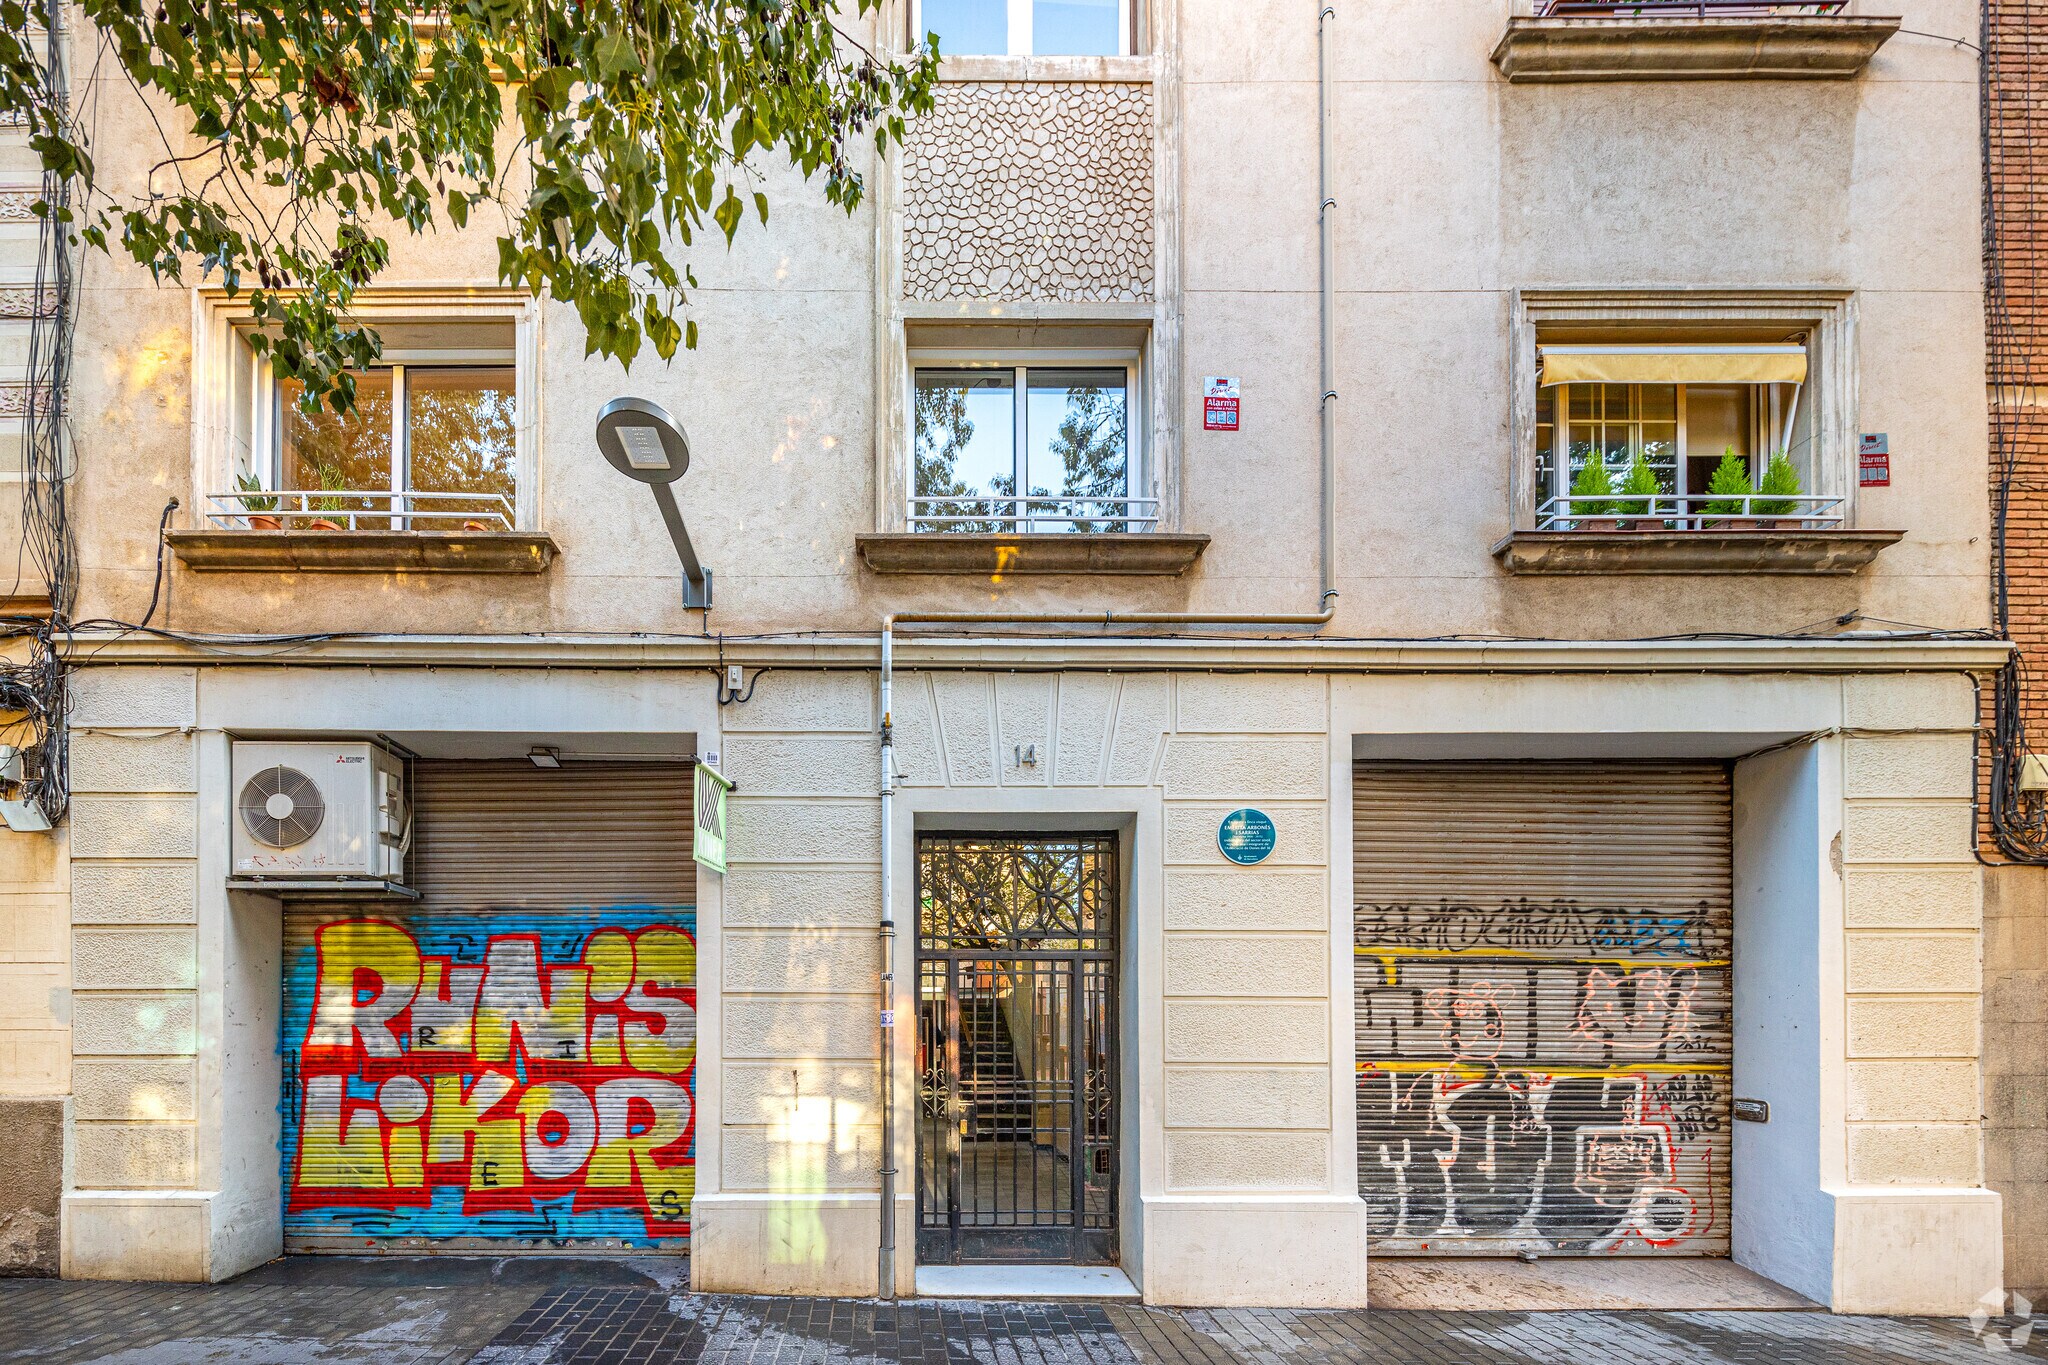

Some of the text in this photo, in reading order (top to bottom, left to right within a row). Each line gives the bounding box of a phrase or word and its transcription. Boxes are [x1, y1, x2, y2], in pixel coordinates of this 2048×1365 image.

[1207, 398, 1237, 407] Alarma
[1860, 442, 1881, 452] Direct
[1014, 744, 1036, 767] 14
